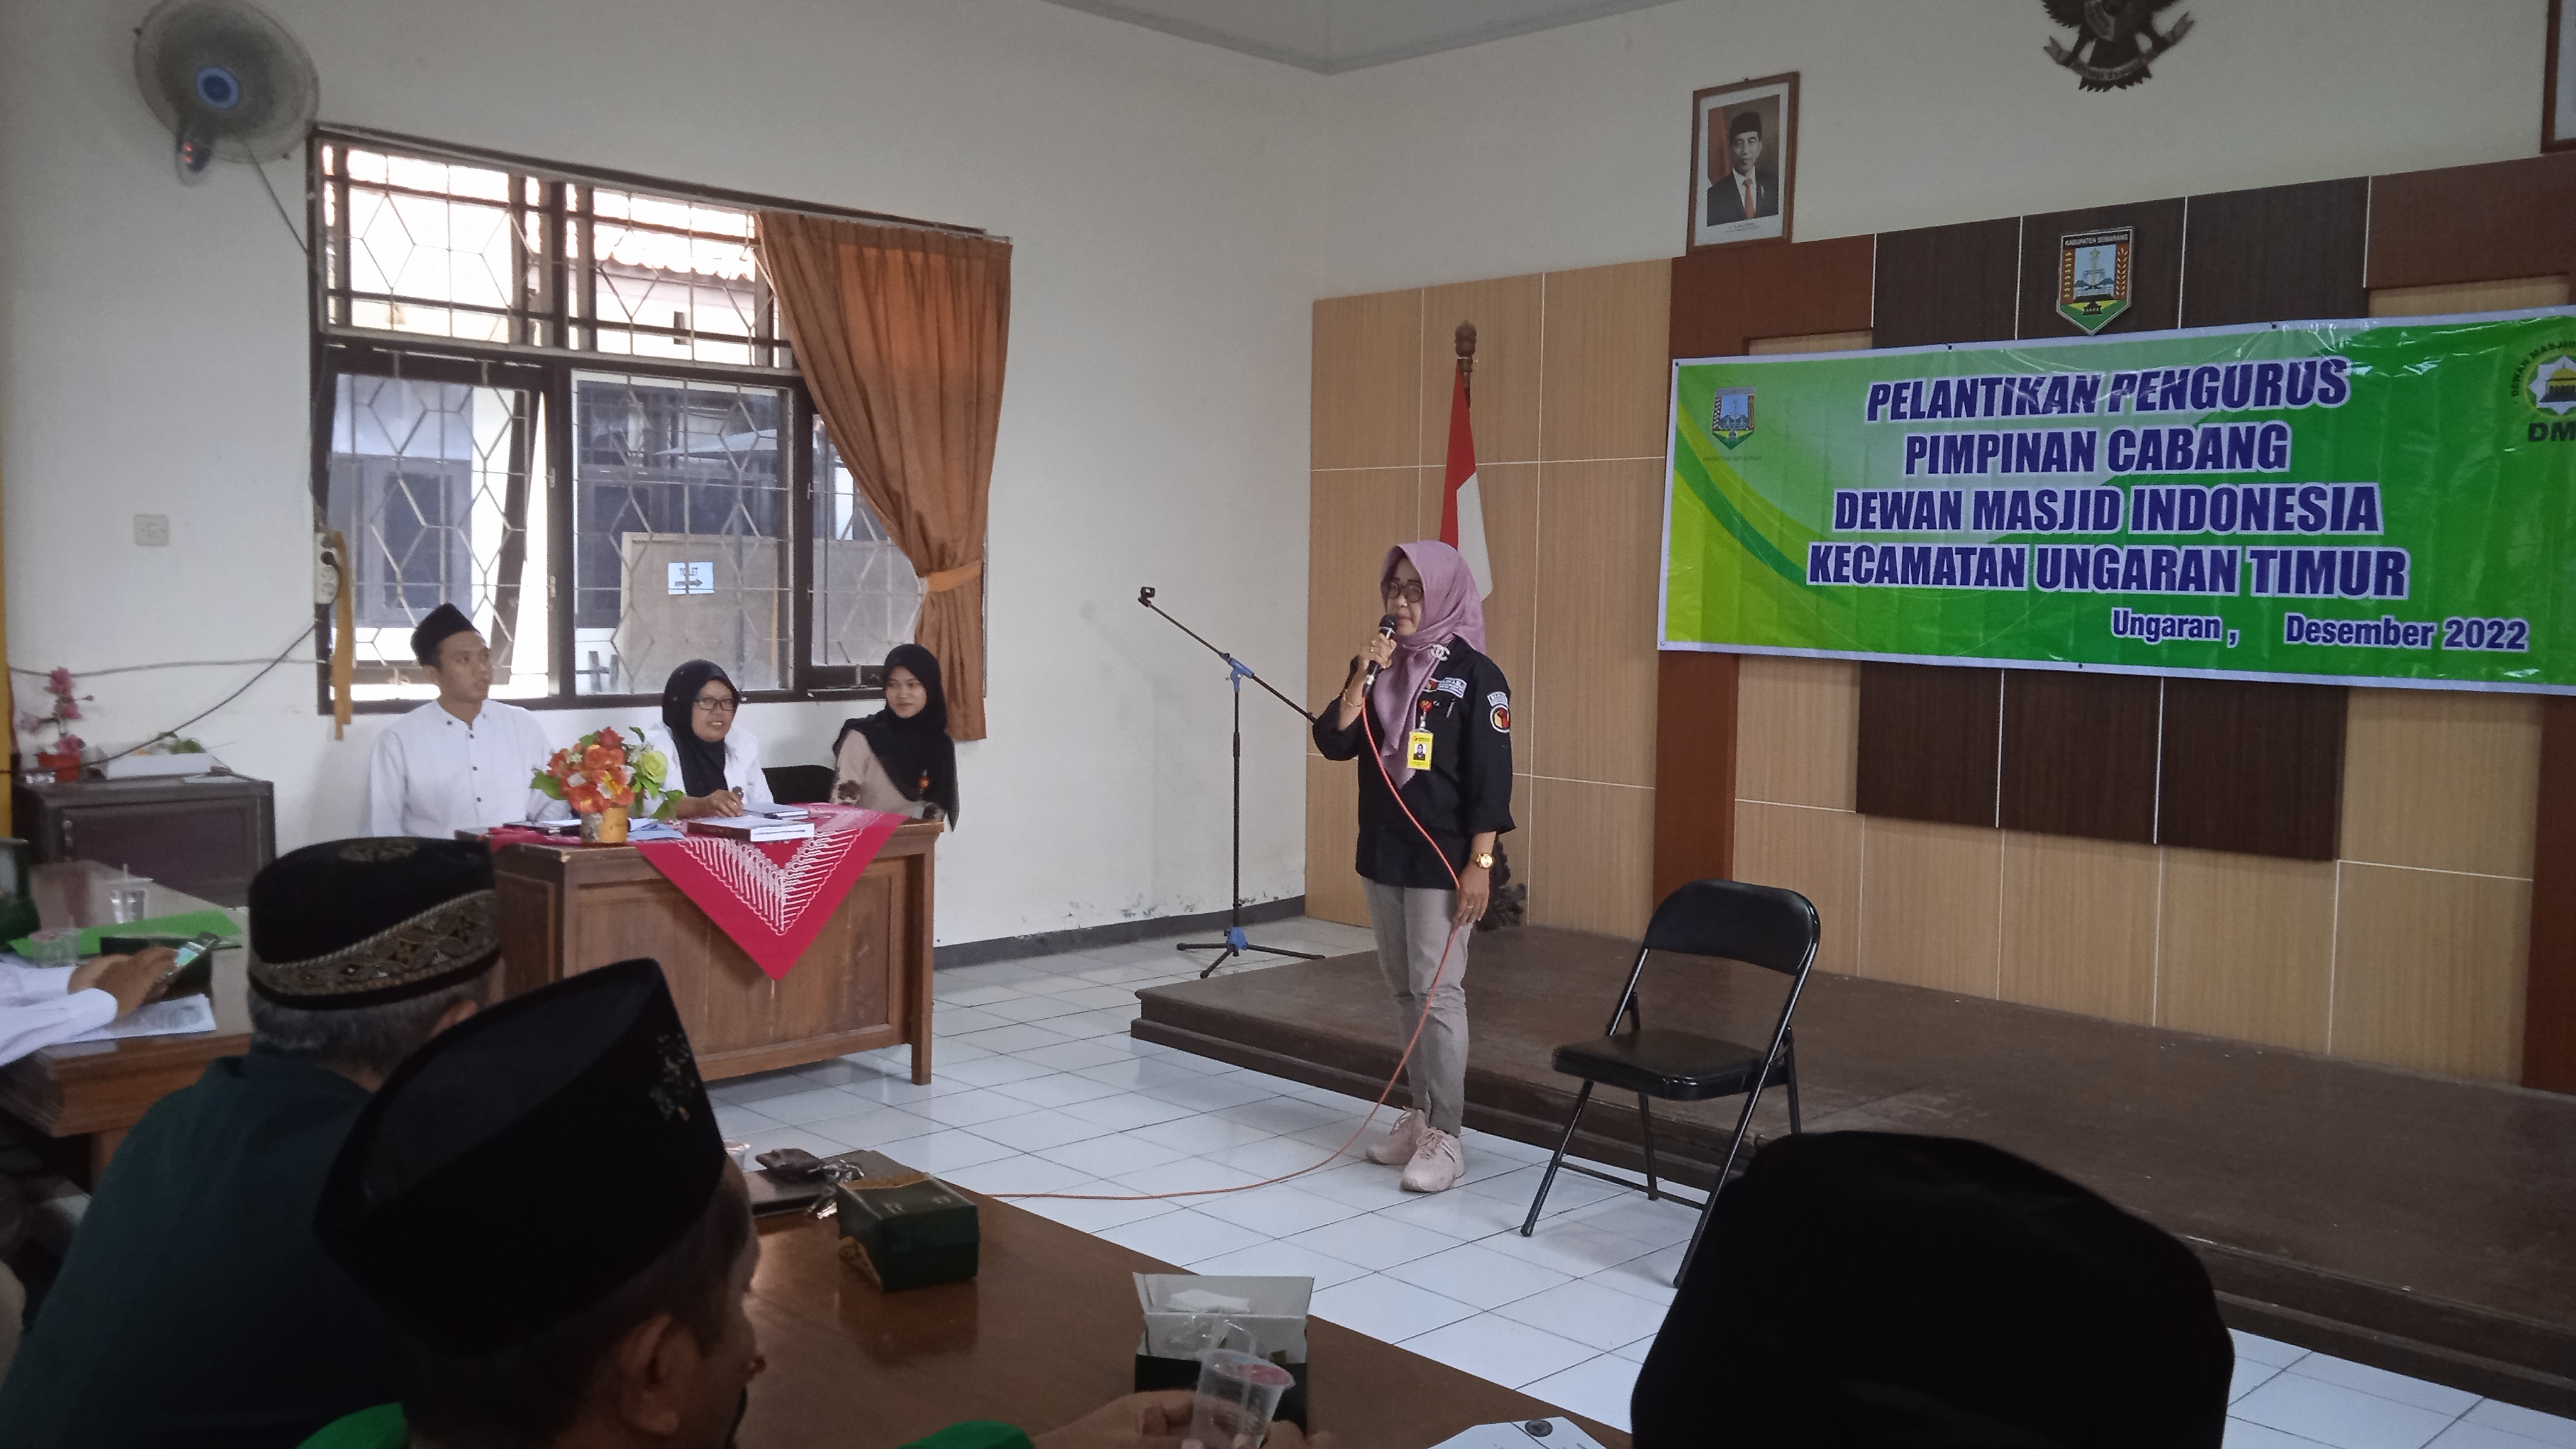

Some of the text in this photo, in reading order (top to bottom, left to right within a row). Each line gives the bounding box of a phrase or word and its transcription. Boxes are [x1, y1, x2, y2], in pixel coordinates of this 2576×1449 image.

[1867, 357, 2350, 424] PELANTIKAN PENGURUS
[1905, 423, 2290, 477] PIMPINAN CABANG
[1834, 485, 2381, 534] DEWAN MASJID INDONESIA
[1809, 544, 2408, 598] KECAMATAN UNGARAN TIMUR
[2286, 615, 2436, 648] Desember
[2445, 619, 2528, 651] 2022
